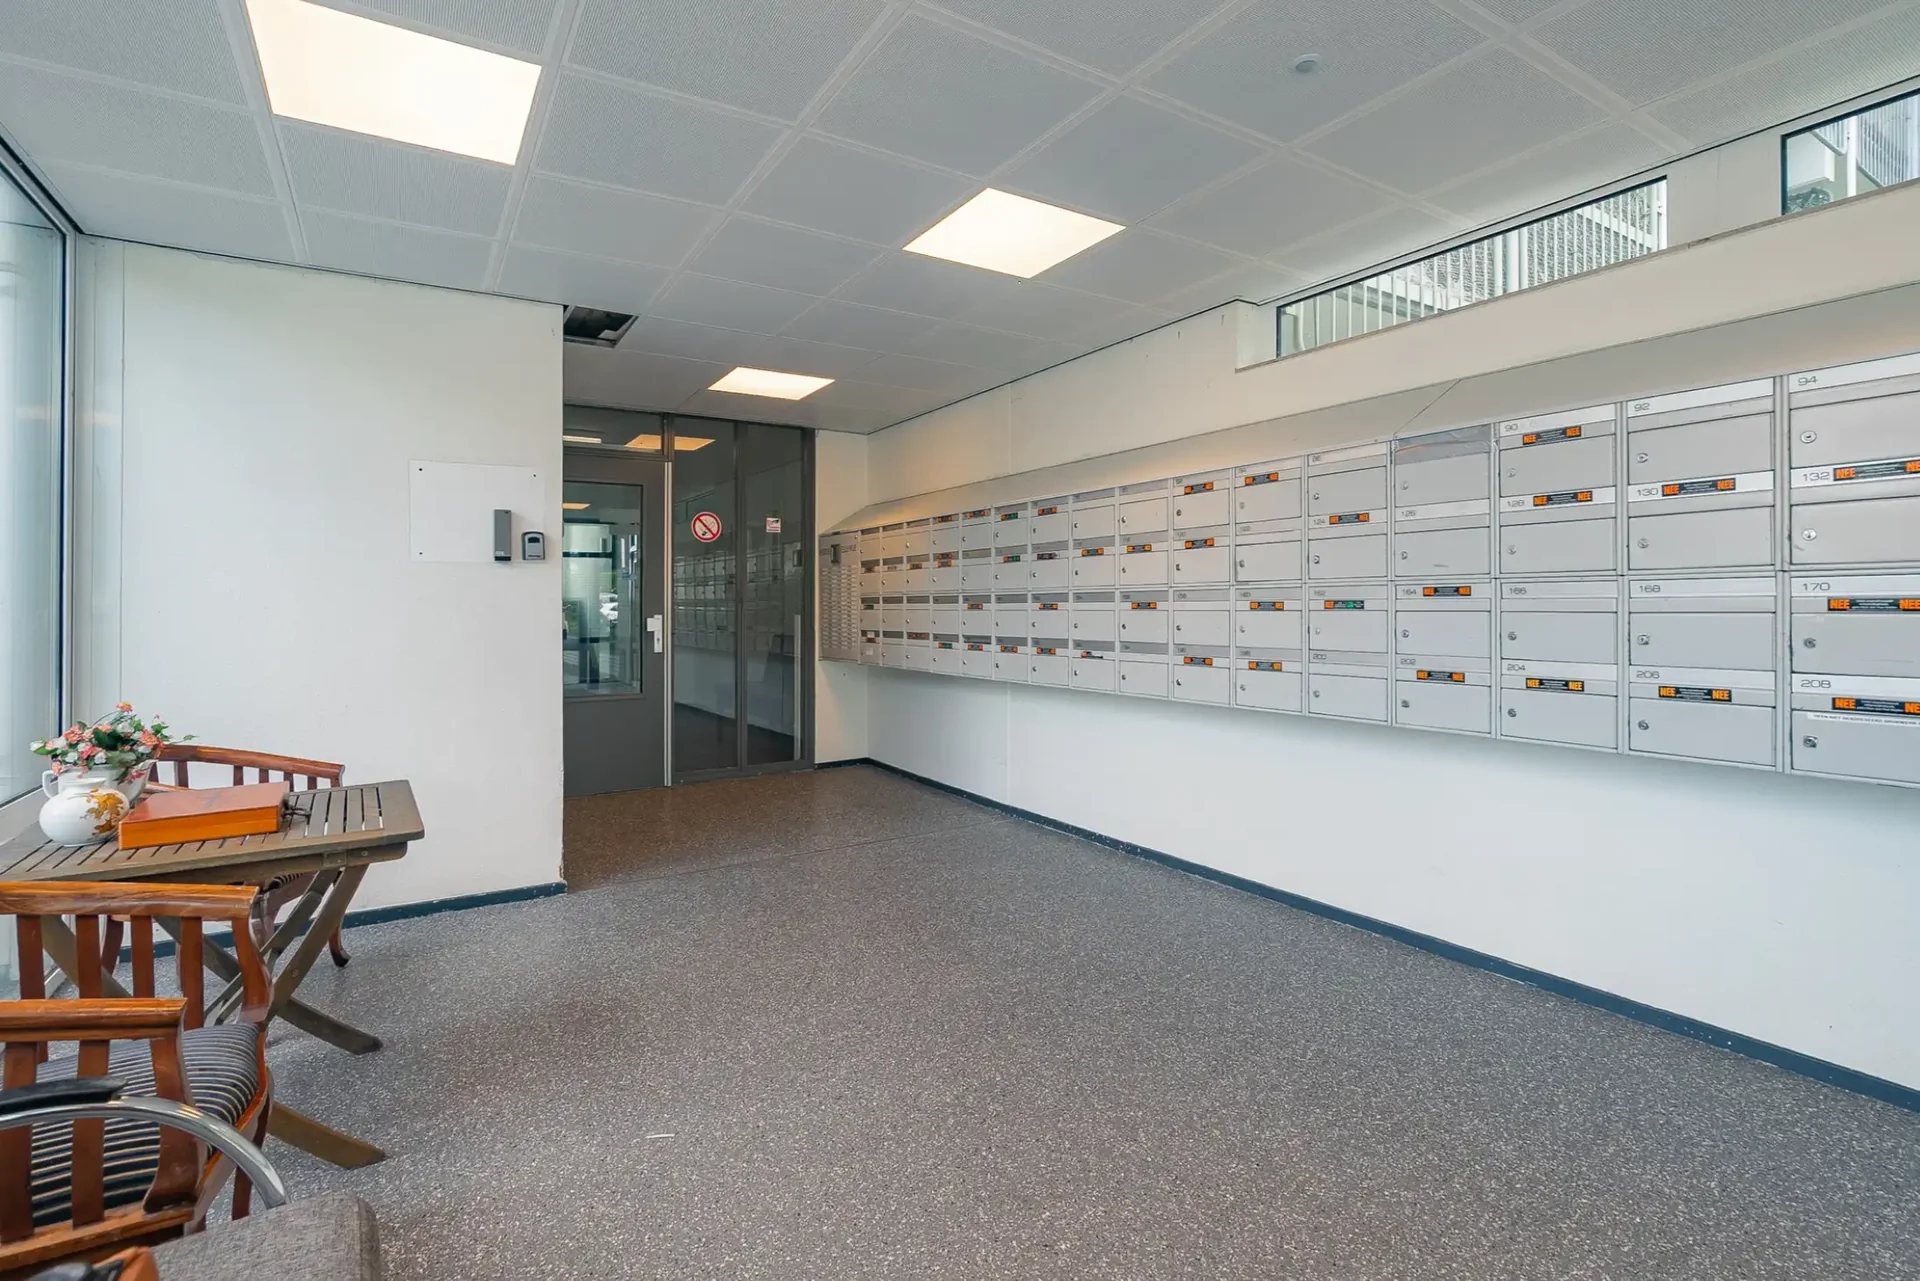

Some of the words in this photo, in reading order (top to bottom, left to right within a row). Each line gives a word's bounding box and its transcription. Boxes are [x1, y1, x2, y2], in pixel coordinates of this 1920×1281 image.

[1797, 375, 1818, 386] 94
[1633, 402, 1650, 412] 92
[1835, 467, 1856, 479] NEE
[1904, 459, 1920, 472] NE
[1802, 471, 1830, 482] 132
[1637, 487, 1659, 497] 130
[1639, 584, 1661, 593] 168
[1802, 582, 1831, 591] 170
[1829, 598, 1850, 610] NEE
[1506, 663, 1526, 672] 204
[1636, 670, 1660, 679] 206
[1801, 679, 1832, 689] 208
[1659, 687, 1676, 697] NEE
[1711, 689, 1730, 701] NEE
[1835, 697, 1856, 709] NEE
[1904, 702, 1920, 713] NE
